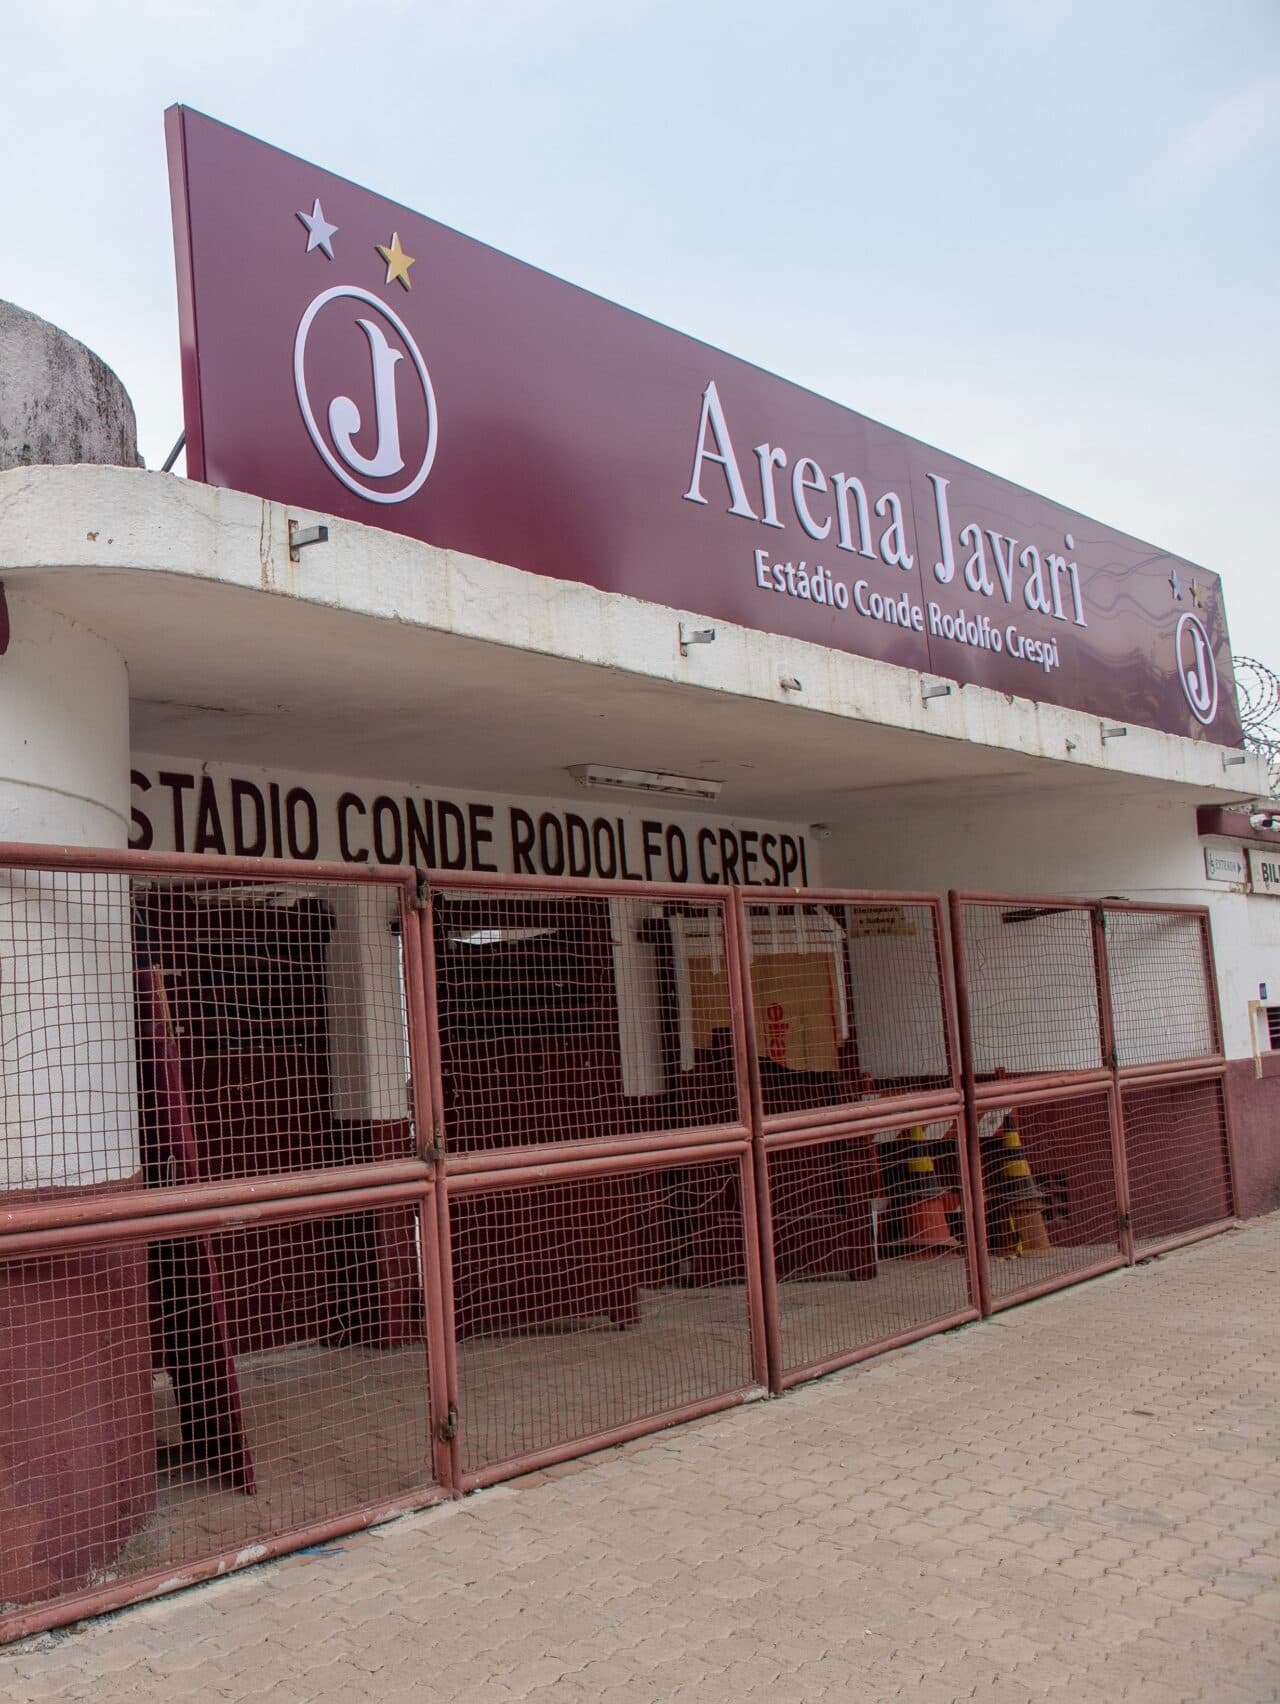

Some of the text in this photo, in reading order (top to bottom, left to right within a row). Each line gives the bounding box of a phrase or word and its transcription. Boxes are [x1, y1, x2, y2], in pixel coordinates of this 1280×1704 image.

[326, 317, 405, 478] J
[683, 380, 1088, 628] Arena Javari
[753, 549, 1060, 673] Estádio Conde Rodolfo Crespi
[1187, 627, 1211, 711] J
[337, 792, 498, 873] CONDE
[509, 806, 688, 883] RODOLFO
[698, 817, 808, 887] CRESPI
[1261, 862, 1280, 884] BIL
